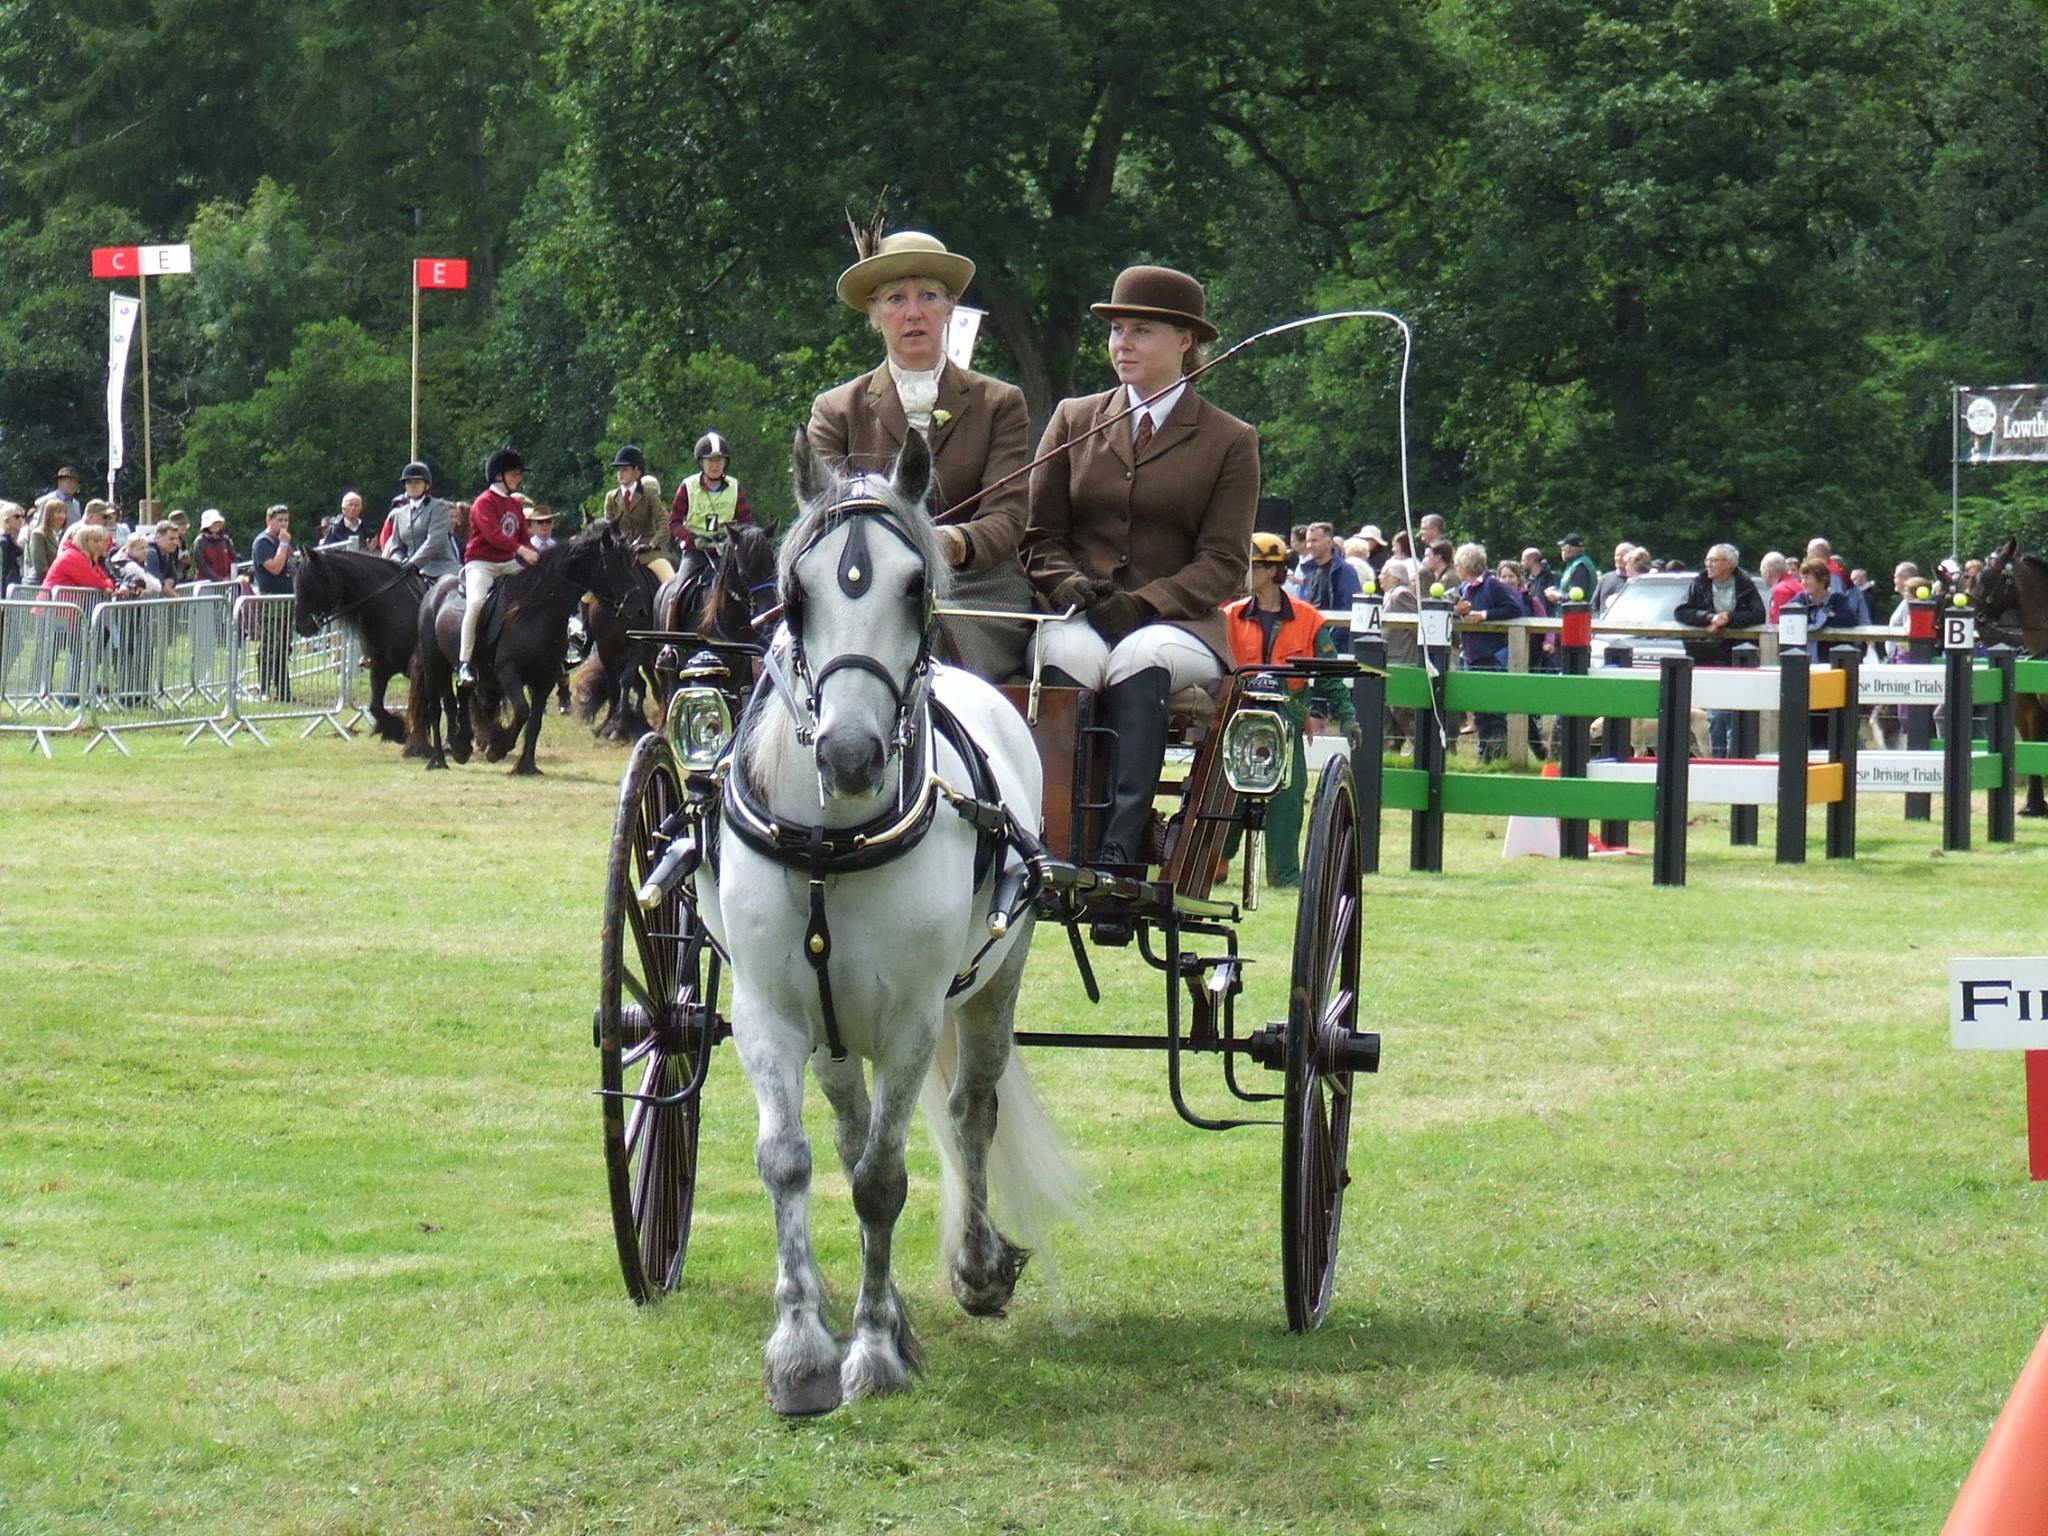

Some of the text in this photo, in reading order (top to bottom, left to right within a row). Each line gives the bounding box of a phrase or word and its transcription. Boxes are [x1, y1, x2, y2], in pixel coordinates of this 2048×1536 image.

[112, 253, 124, 270] C
[159, 250, 170, 269] E
[433, 262, 446, 284] E
[2003, 411, 2048, 438] Lowth
[707, 515, 717, 531] 7
[1368, 606, 1381, 629] A
[1949, 620, 1965, 644] B
[1858, 679, 1943, 696] se Driving Trials
[1872, 767, 1910, 784] Driving
[1912, 767, 1942, 781] Trials
